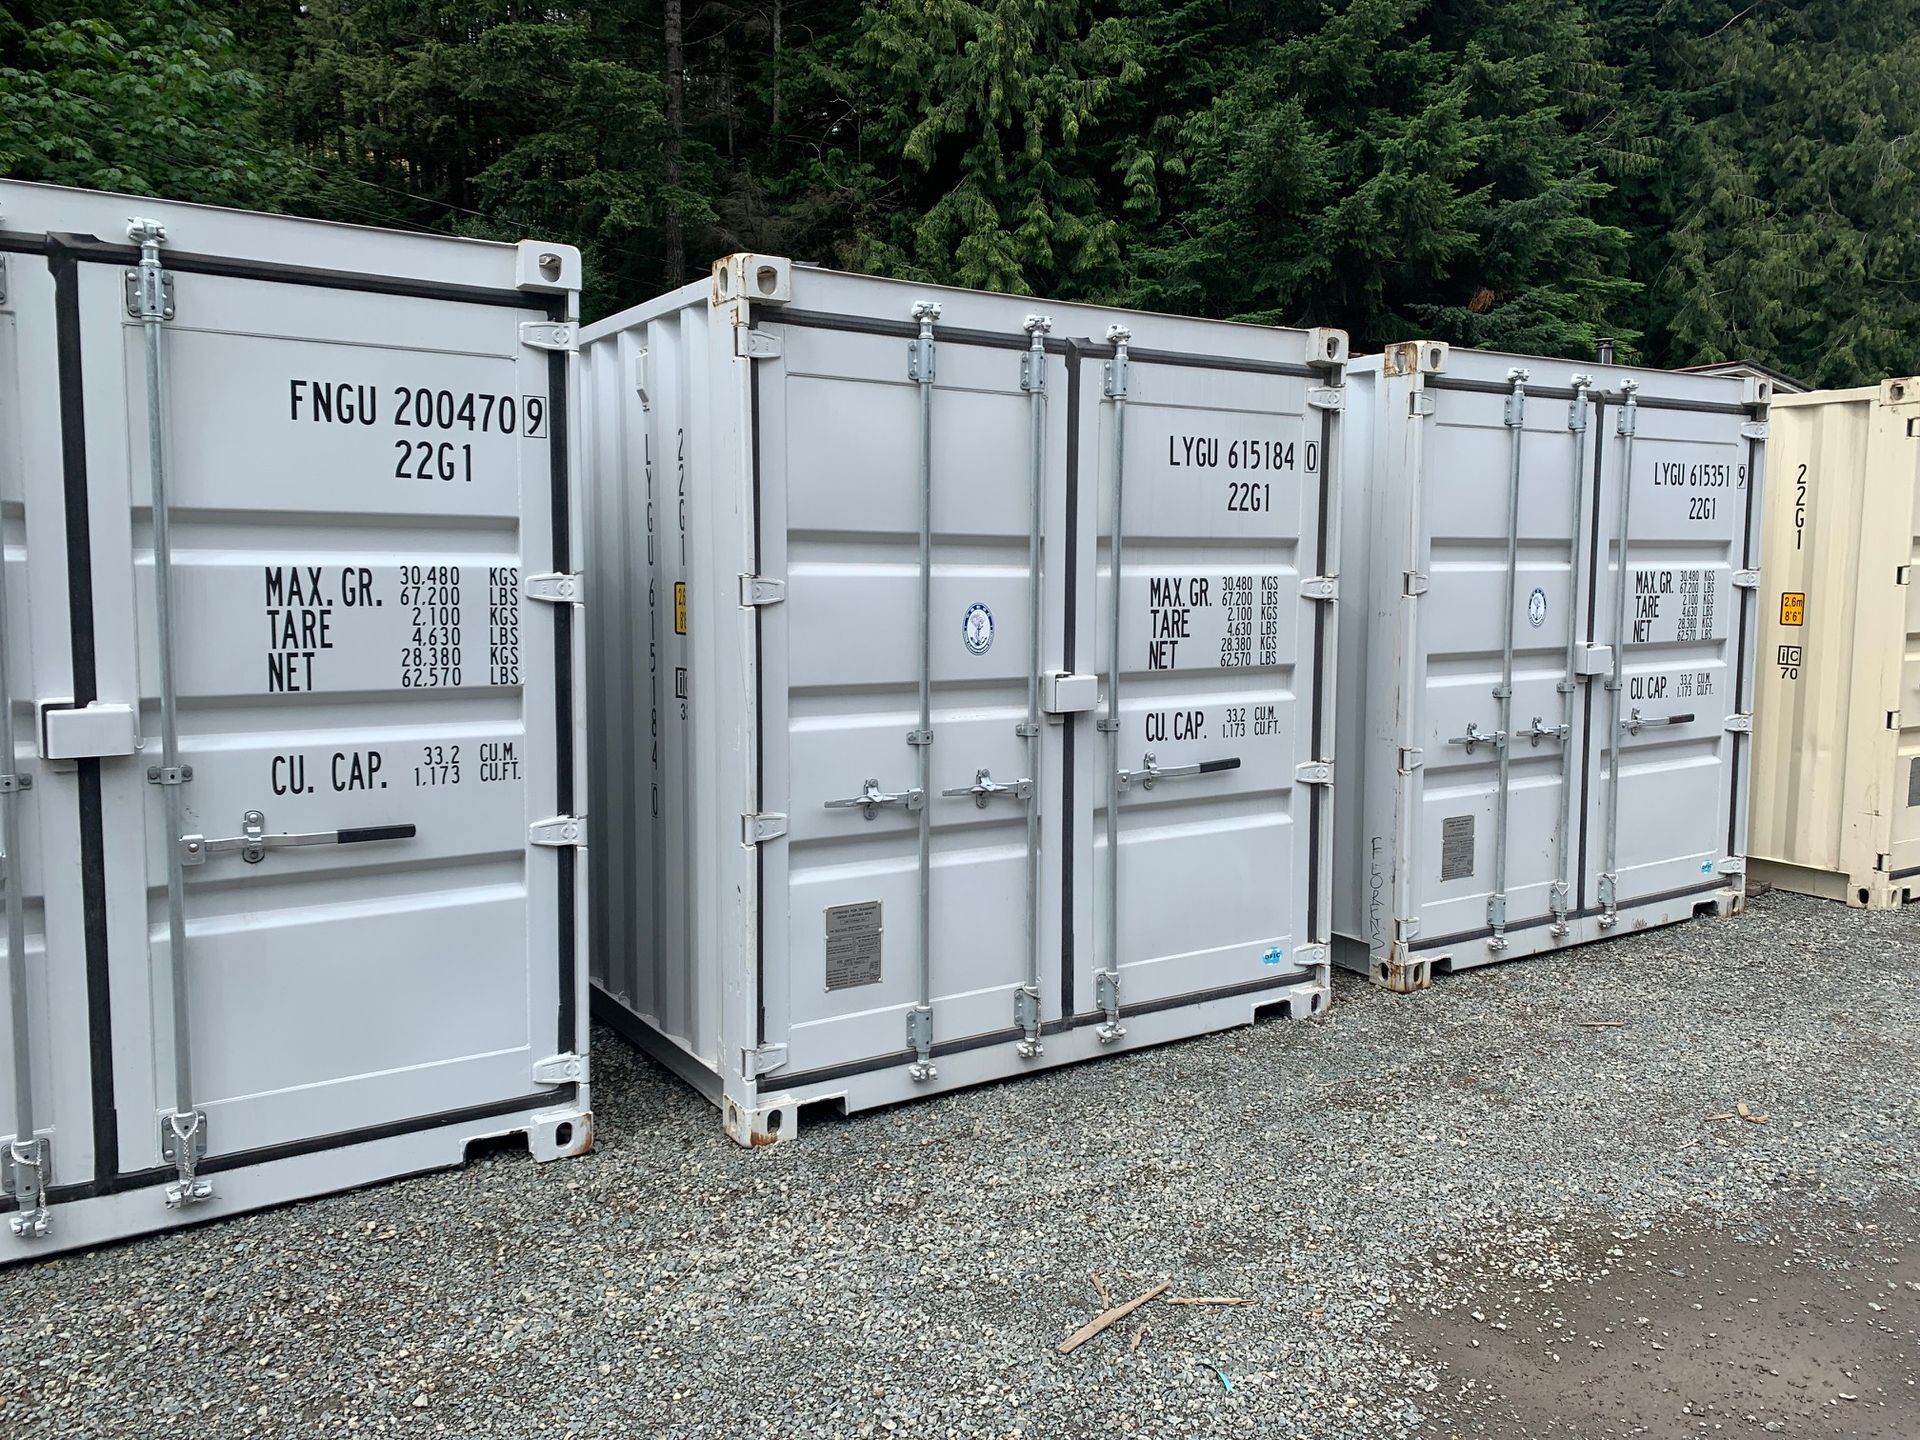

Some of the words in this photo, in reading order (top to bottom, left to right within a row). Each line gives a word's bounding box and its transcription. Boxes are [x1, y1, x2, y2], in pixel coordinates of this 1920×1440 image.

[290, 379, 377, 426] FNGU
[394, 386, 516, 434] 200470
[526, 397, 544, 435] 9
[394, 439, 472, 482] 22G1
[1169, 435, 1218, 467] LYGU
[1228, 440, 1294, 471] 615184
[1306, 443, 1317, 471] 0
[1654, 462, 1685, 485] LYGU
[1690, 464, 1730, 487] 615351
[1738, 466, 1746, 487] 9
[1227, 482, 1270, 512] 22G1
[1795, 464, 1807, 550] 22G1
[1688, 497, 1716, 520] 22G1
[489, 567, 518, 586] KGS
[1261, 575, 1279, 590] KGS
[1635, 571, 1657, 594] MAX.
[1660, 571, 1674, 594] GR.
[1704, 570, 1715, 582] KGS
[265, 566, 333, 607] MAX.
[341, 567, 383, 607] GR.
[489, 587, 518, 606] LBS
[1150, 577, 1185, 607] MAX.
[1189, 577, 1212, 607] GR.
[1703, 582, 1714, 594] LBS
[1261, 591, 1278, 606] LBS
[1635, 595, 1660, 618] TARE
[1703, 594, 1714, 605] KGS
[489, 607, 519, 626] KGS
[1260, 606, 1278, 621] KGS
[1702, 606, 1713, 617] LBS
[267, 609, 333, 649] TARE
[1150, 609, 1190, 639] TARE
[1260, 621, 1277, 636] LBS
[1633, 620, 1652, 642] NET
[1702, 617, 1713, 629] KGS
[489, 626, 519, 646] LBS
[1260, 636, 1277, 651] KGS
[1701, 629, 1712, 640] LBS
[490, 646, 519, 666] KGS
[1149, 640, 1179, 670] NET
[1259, 651, 1276, 665] LBS
[268, 652, 315, 692] NET
[490, 666, 519, 686] LBS
[1680, 674, 1692, 685] 33.2
[1780, 667, 1798, 680] 70
[1630, 677, 1644, 700] CU.
[1647, 676, 1668, 699] CAP.
[1226, 708, 1246, 723] 33.2
[1145, 712, 1168, 742] CU.
[1174, 711, 1207, 740] CAP.
[423, 745, 460, 765] 33.2
[479, 742, 517, 762] CU.M.
[271, 754, 314, 796] CU.
[331, 751, 387, 791] CAP.
[479, 762, 521, 782] CU.FT.
